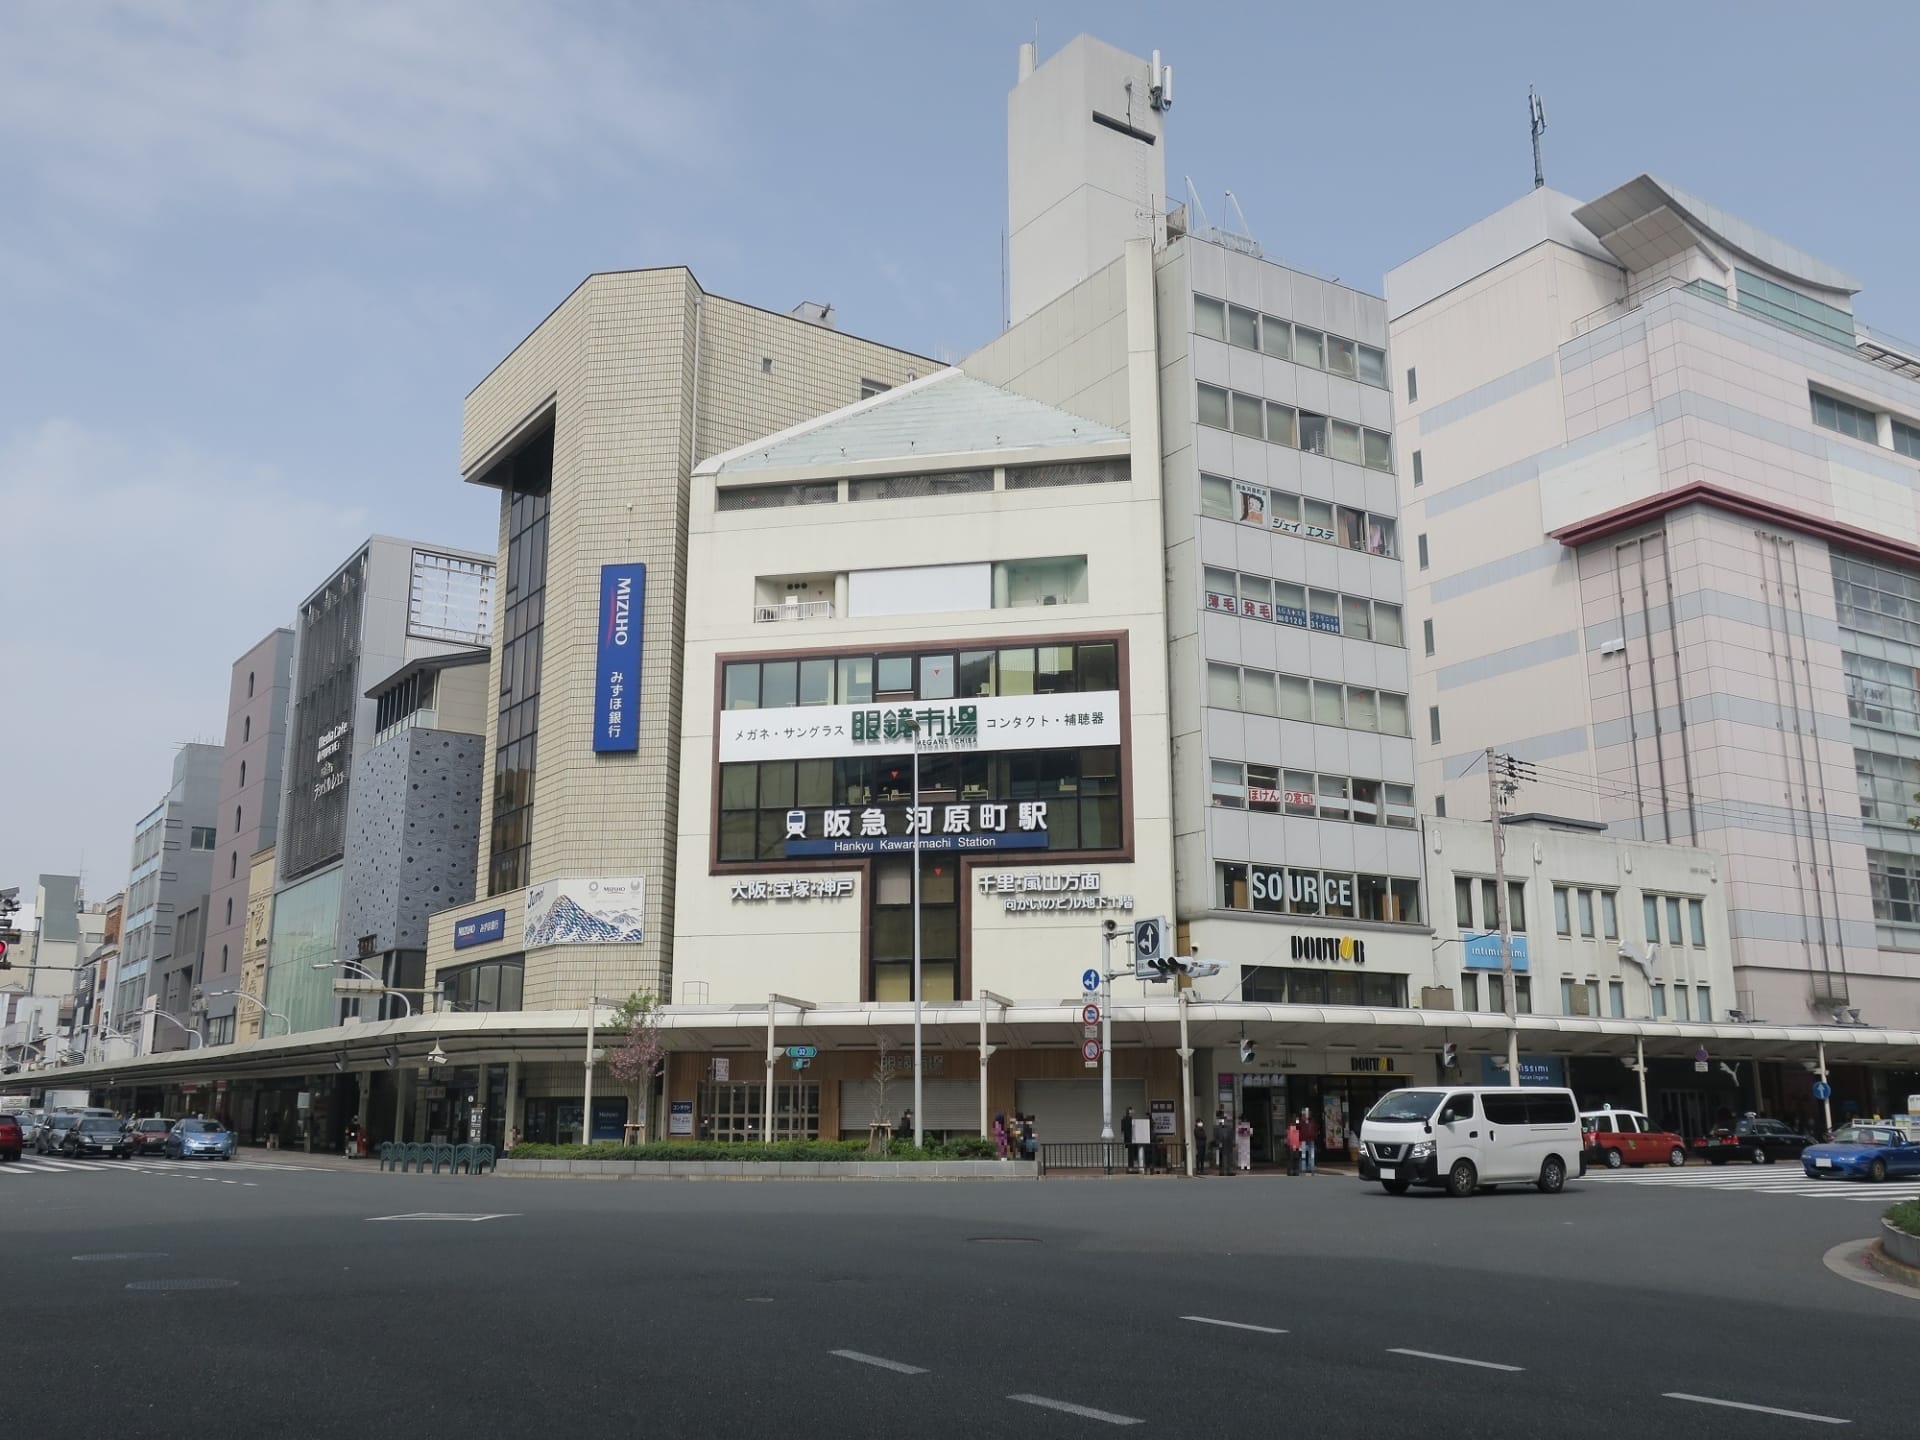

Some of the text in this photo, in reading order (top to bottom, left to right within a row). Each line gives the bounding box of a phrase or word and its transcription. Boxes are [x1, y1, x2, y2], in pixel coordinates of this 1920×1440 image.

[615, 578, 631, 646] MIZUHO
[1208, 594, 1271, 619] 薄毛 発毛
[608, 671, 623, 738] みずほ銀行
[735, 705, 1105, 741] メガネ・サングラス 眼鏡市場 コンタクト・補聴器
[951, 735, 977, 744] ICHIBA
[823, 801, 1047, 838] 阪急 河原町駅
[834, 841, 874, 853] Hankyu
[958, 837, 996, 848] Station
[731, 878, 854, 899] 大阪・宝塚・神戸
[978, 872, 1100, 893] 千里・嵐山方面
[1252, 871, 1352, 906] SOURCE
[1290, 935, 1365, 963] DOUTOR
[1351, 1056, 1394, 1071] DOUTOR
